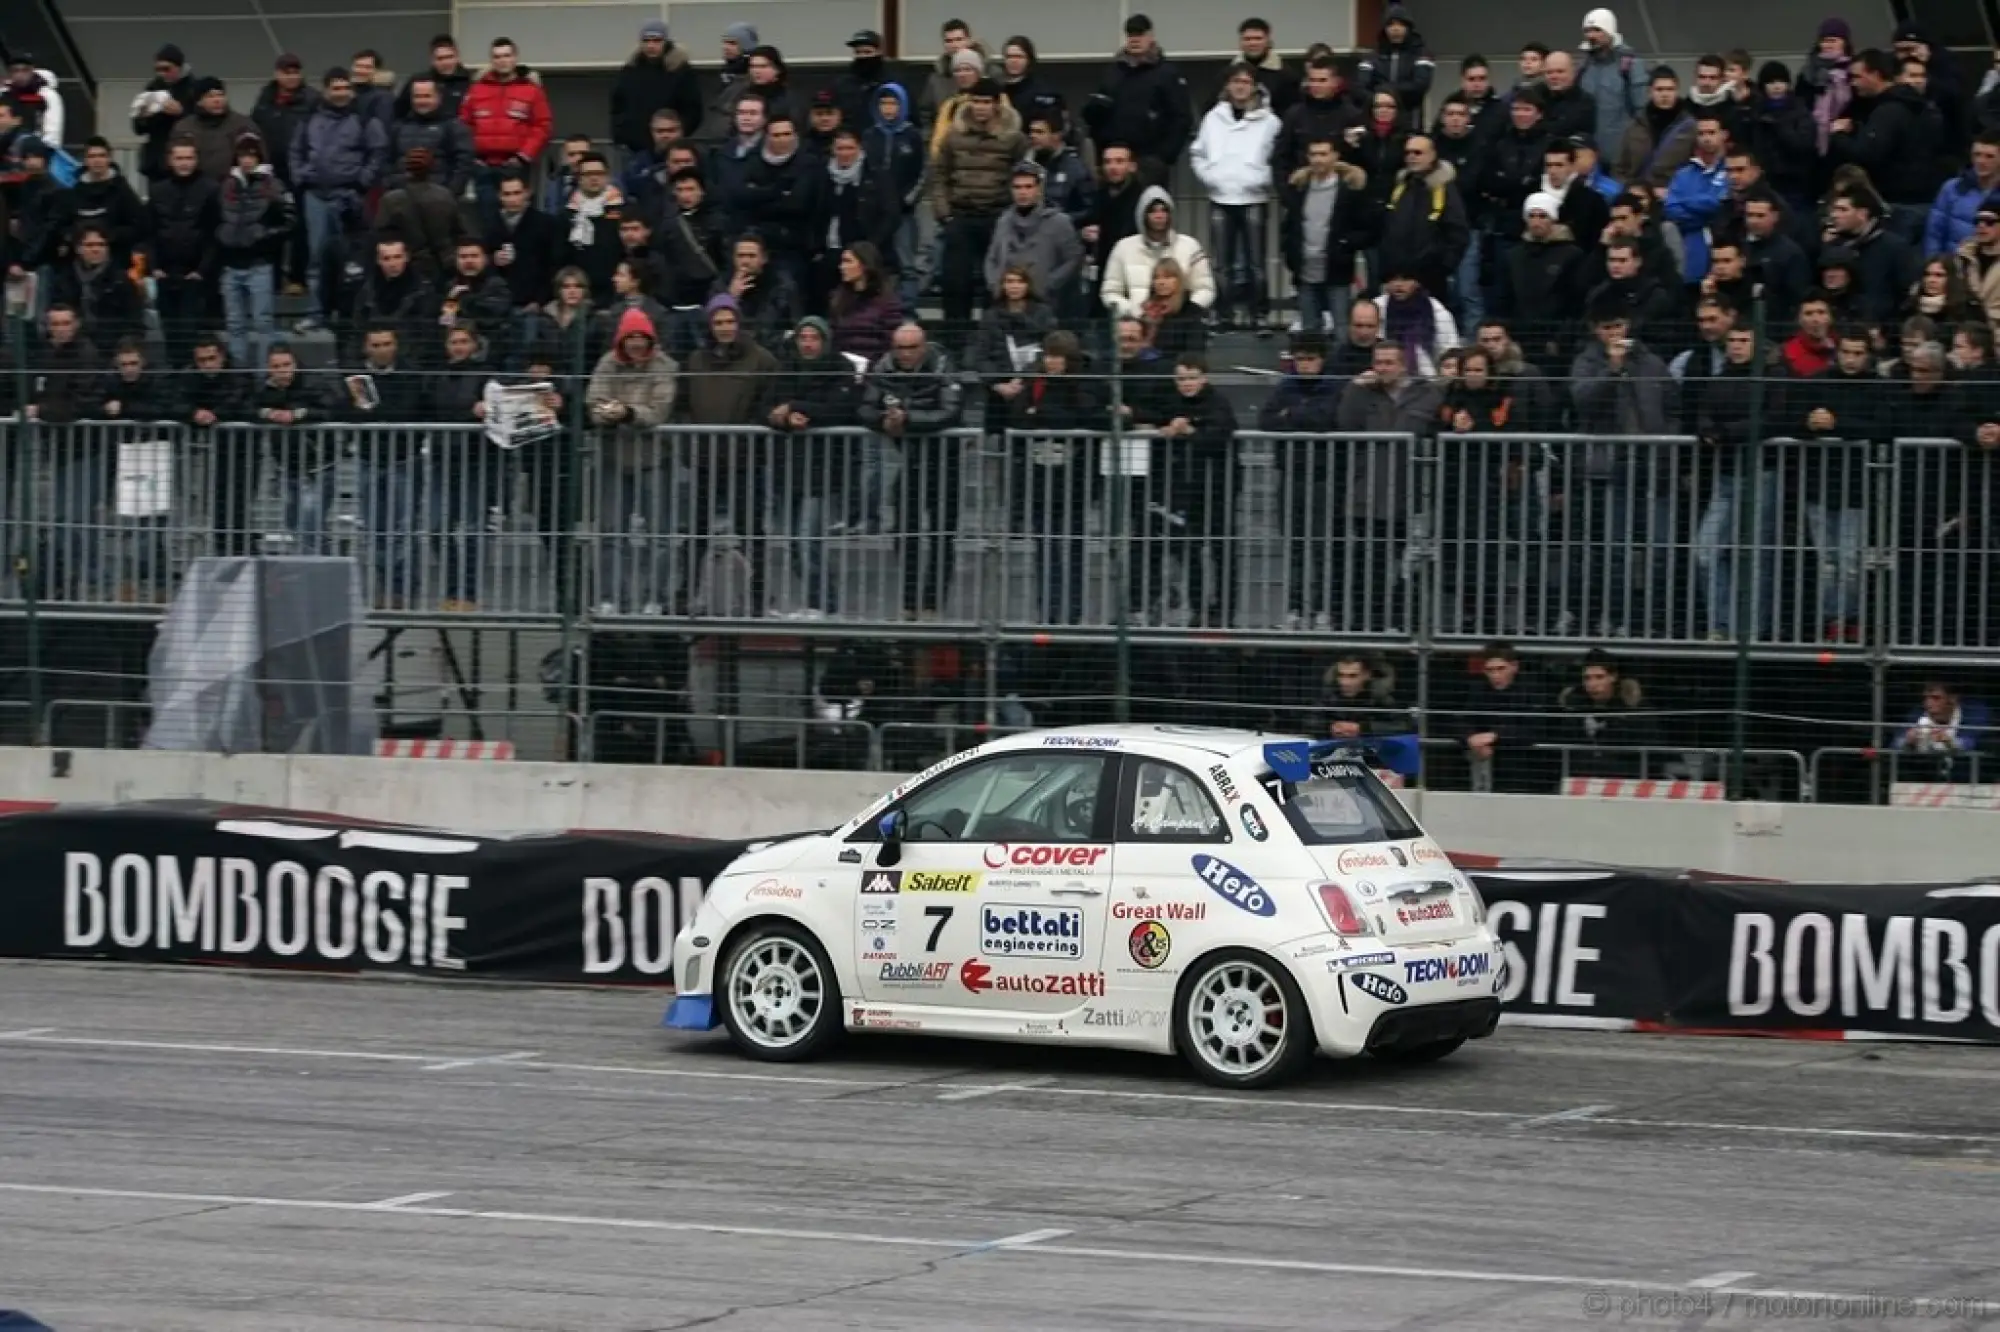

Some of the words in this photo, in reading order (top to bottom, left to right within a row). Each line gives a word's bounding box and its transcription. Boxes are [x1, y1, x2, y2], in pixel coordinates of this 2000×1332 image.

[1208, 763, 1241, 806] ABRAX
[1265, 778, 1287, 806] 7
[1011, 845, 1108, 866] cover
[909, 872, 972, 892] Sabelt
[1199, 857, 1265, 911] Hero
[64, 851, 470, 970] BOMBOOGIE
[984, 909, 1079, 938] bettati
[1112, 902, 1163, 919] Great
[1167, 901, 1206, 919] Wall
[582, 876, 704, 974] BO
[924, 905, 954, 952] 7
[984, 937, 1079, 956] engineering
[879, 962, 954, 980] PubbliART
[996, 971, 1105, 997] autozatti
[1361, 974, 1402, 1001] Hero
[1083, 1007, 1124, 1027] Zatti
